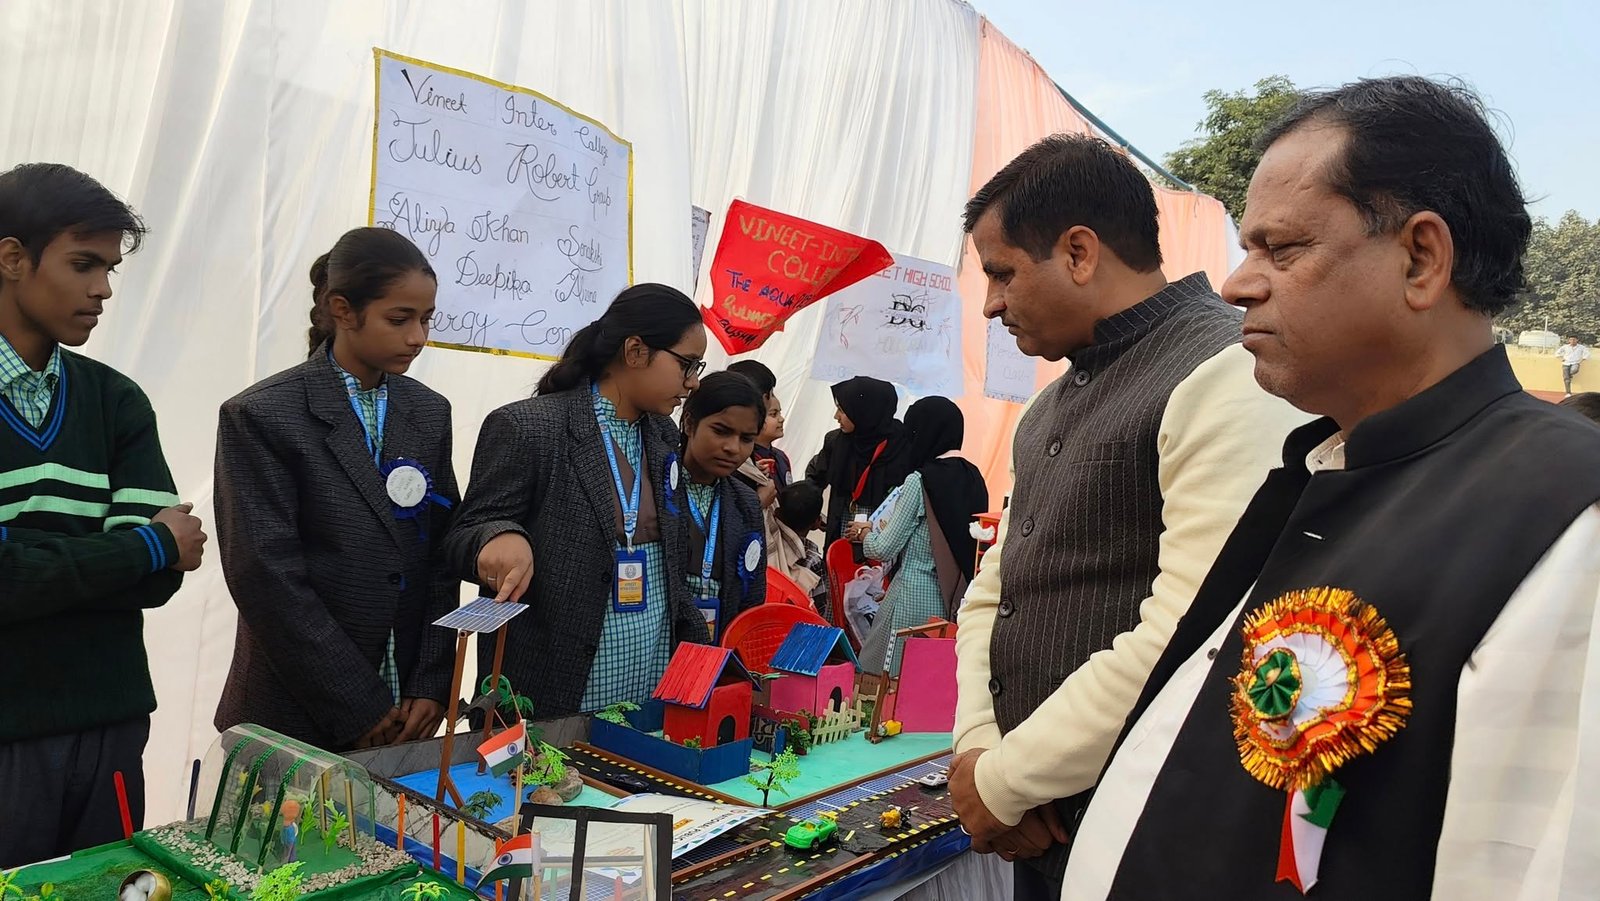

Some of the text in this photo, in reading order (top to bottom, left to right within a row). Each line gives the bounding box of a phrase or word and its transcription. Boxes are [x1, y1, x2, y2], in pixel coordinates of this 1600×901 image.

[401, 68, 468, 115] Vineet
[502, 94, 558, 137] Inter
[505, 141, 581, 202] Robert
[465, 210, 529, 244] Khan
[455, 250, 534, 301] Deepika
[726, 269, 752, 292] THE
[429, 310, 499, 348] ergy
